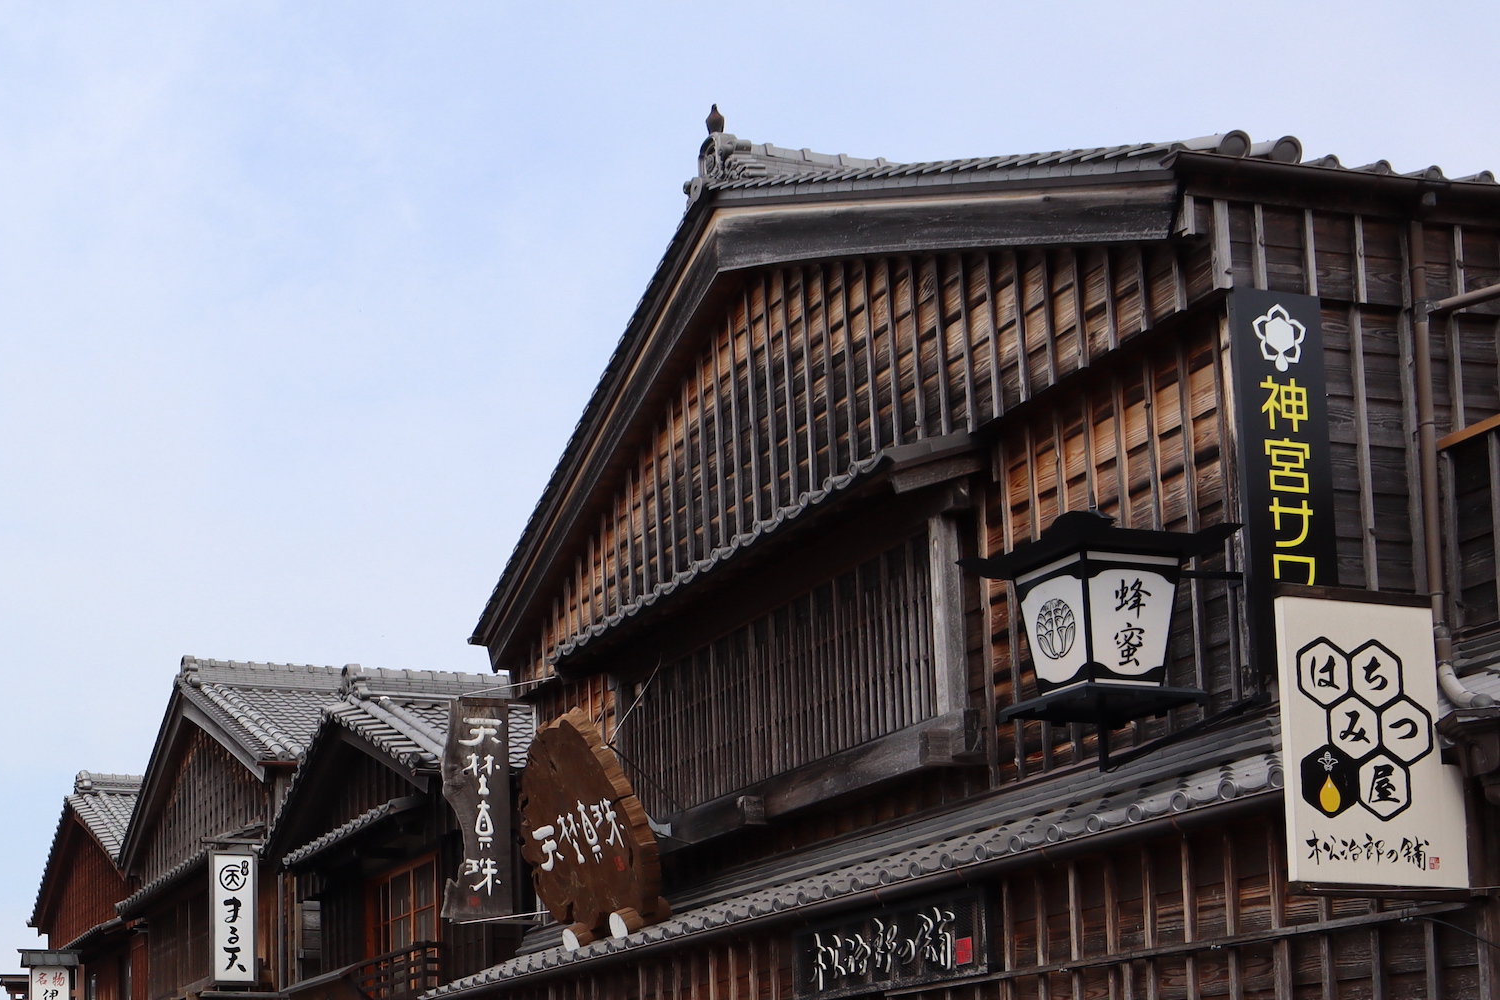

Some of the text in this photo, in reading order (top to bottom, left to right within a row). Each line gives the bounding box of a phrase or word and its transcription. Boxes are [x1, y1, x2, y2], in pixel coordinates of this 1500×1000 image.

[1114, 577, 1151, 667] 蜂蜜
[1368, 763, 1401, 804] 屋
[1305, 829, 1431, 872] 松治郎の舗
[223, 896, 247, 973] まる天
[35, 972, 65, 987] 名物
